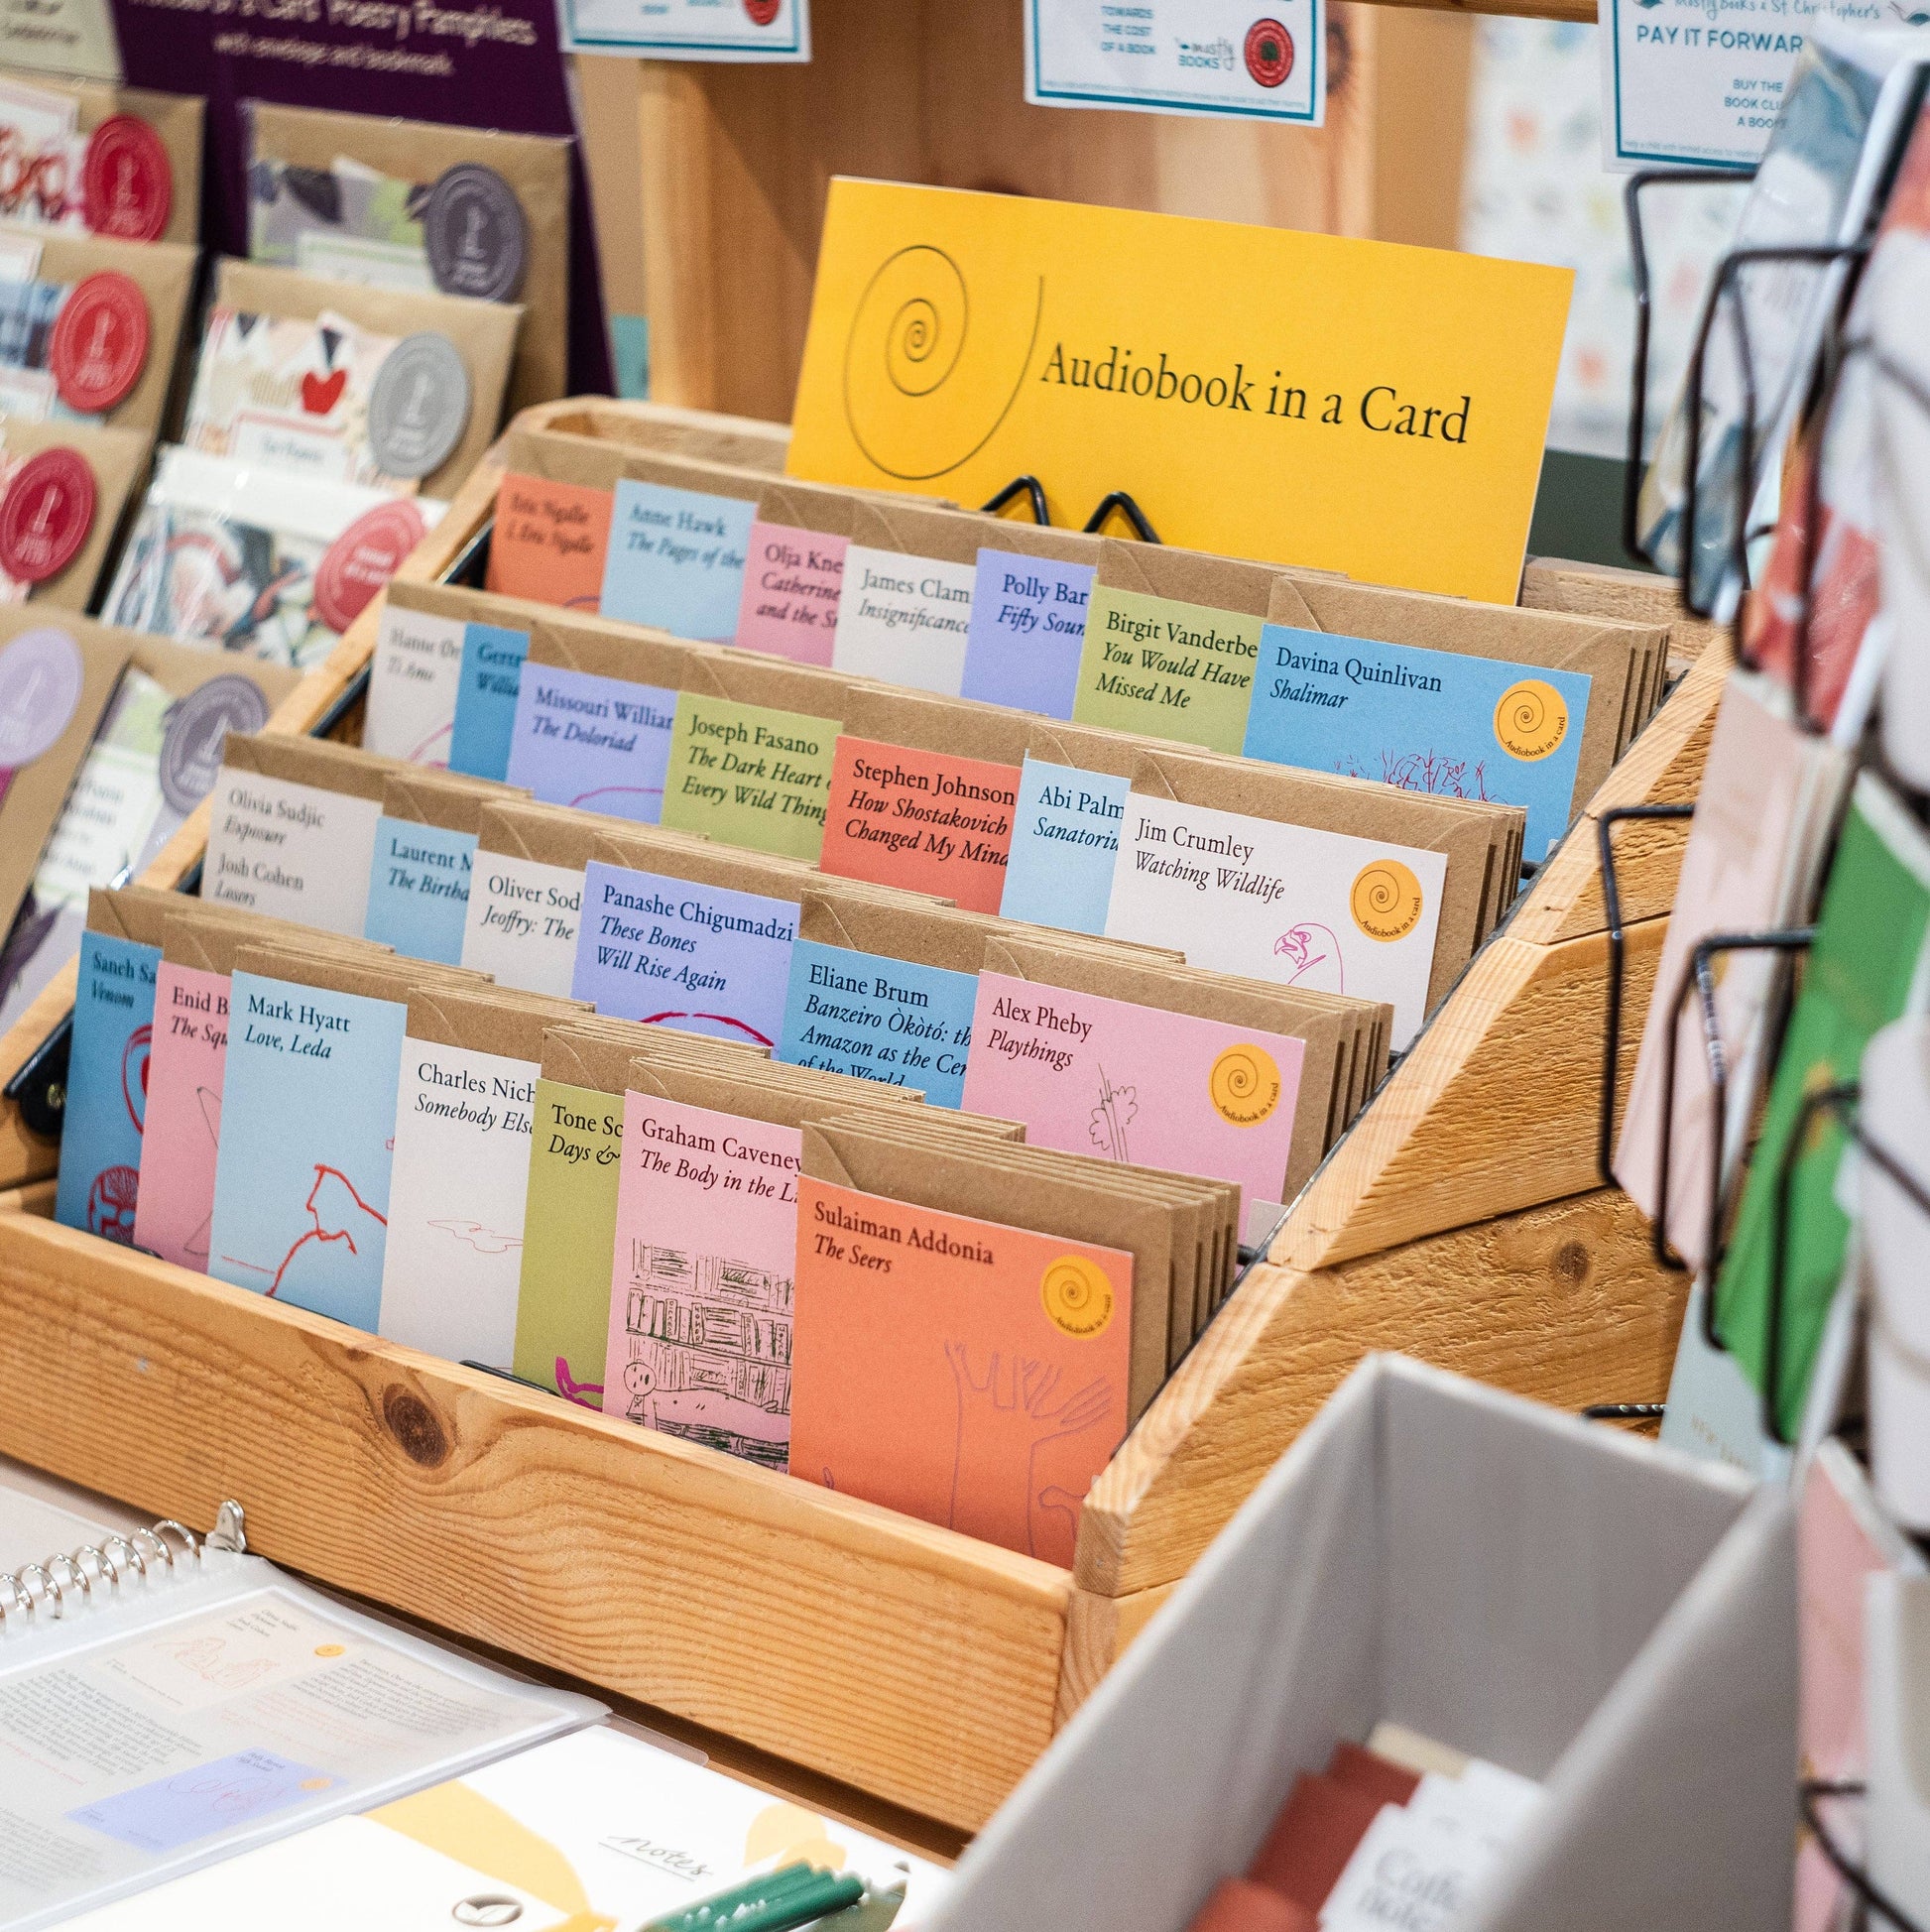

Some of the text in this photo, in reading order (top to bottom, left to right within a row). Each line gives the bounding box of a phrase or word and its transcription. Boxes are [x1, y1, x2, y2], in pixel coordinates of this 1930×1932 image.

[1102, 23, 1152, 37] THE COST
[1636, 25, 1804, 54] PAY IT FORWAR
[1178, 55, 1220, 69] BOOKS
[1724, 96, 1758, 108] BOOK
[1733, 79, 1783, 92] BUY THE
[1737, 116, 1745, 126] A
[1040, 342, 1472, 443] Audiobook in a Card
[861, 568, 970, 604] James Clam
[1003, 574, 1089, 605] Polly Bar
[756, 602, 817, 625] and the
[997, 605, 1039, 634] Fifty
[1106, 611, 1259, 658] Birgit Vanderbe
[1102, 642, 1251, 688] You Would Have
[1274, 646, 1442, 693] Davina Quinlivan
[536, 685, 609, 718] Missouri
[1095, 672, 1191, 709] Missed Me
[1269, 678, 1348, 709] Shalimar
[533, 714, 638, 752] The Doloriad
[688, 714, 819, 756] Joseph Fasano
[1505, 740, 1546, 757] Audiobook
[1544, 741, 1554, 750] in
[1556, 716, 1566, 735] card
[688, 746, 717, 768] The
[721, 753, 767, 779] Dark
[771, 762, 822, 788] Heart
[853, 759, 929, 790] Stephen
[932, 774, 1015, 805] Johnson
[227, 787, 273, 815] Olivia
[681, 776, 728, 805] Every
[735, 785, 778, 810] Wild
[1038, 785, 1125, 819] Abi Palm
[847, 789, 1008, 836] How Shostakovich
[390, 838, 454, 869] Laurent
[845, 818, 922, 852] Changed
[923, 833, 956, 861] My
[1135, 817, 1255, 866] Jim Crumley
[217, 852, 249, 878] Josh
[388, 868, 416, 890] The
[1136, 850, 1285, 905] Watching Wildlife
[489, 875, 582, 911] Oliver Sod
[481, 905, 574, 940] Jeoffry: The
[603, 884, 793, 942] Panashe Chigumadzi
[1362, 920, 1401, 937] Audiobook
[1401, 921, 1410, 931] in
[1412, 897, 1421, 916] card
[599, 915, 697, 953] These Bones
[597, 945, 727, 992] Will Rise Again
[808, 963, 929, 1008] Eliane Brum
[173, 986, 230, 1017] Enid B
[248, 994, 351, 1032] Mark Hyatt
[803, 994, 882, 1027] Banzeiro
[992, 997, 1093, 1042] Alex Pheby
[171, 1015, 198, 1038] The
[244, 1024, 332, 1059] Love, Leda
[799, 1025, 874, 1057] Amazon
[877, 1046, 898, 1062] as
[903, 1046, 930, 1069] the
[987, 1028, 1073, 1072] Playthings
[418, 1062, 486, 1093] Charles
[415, 1093, 498, 1132] Somebody
[551, 1103, 624, 1138] Tone Sc
[1220, 1105, 1260, 1122] Audiobook
[1269, 1082, 1278, 1101] card
[548, 1134, 621, 1165] Days &
[642, 1118, 716, 1152] Graham
[641, 1148, 776, 1198] The Body in the
[814, 1200, 994, 1265] Sulaiman Addonia
[814, 1233, 893, 1273] The Seers
[608, 1835, 713, 1877] notes
